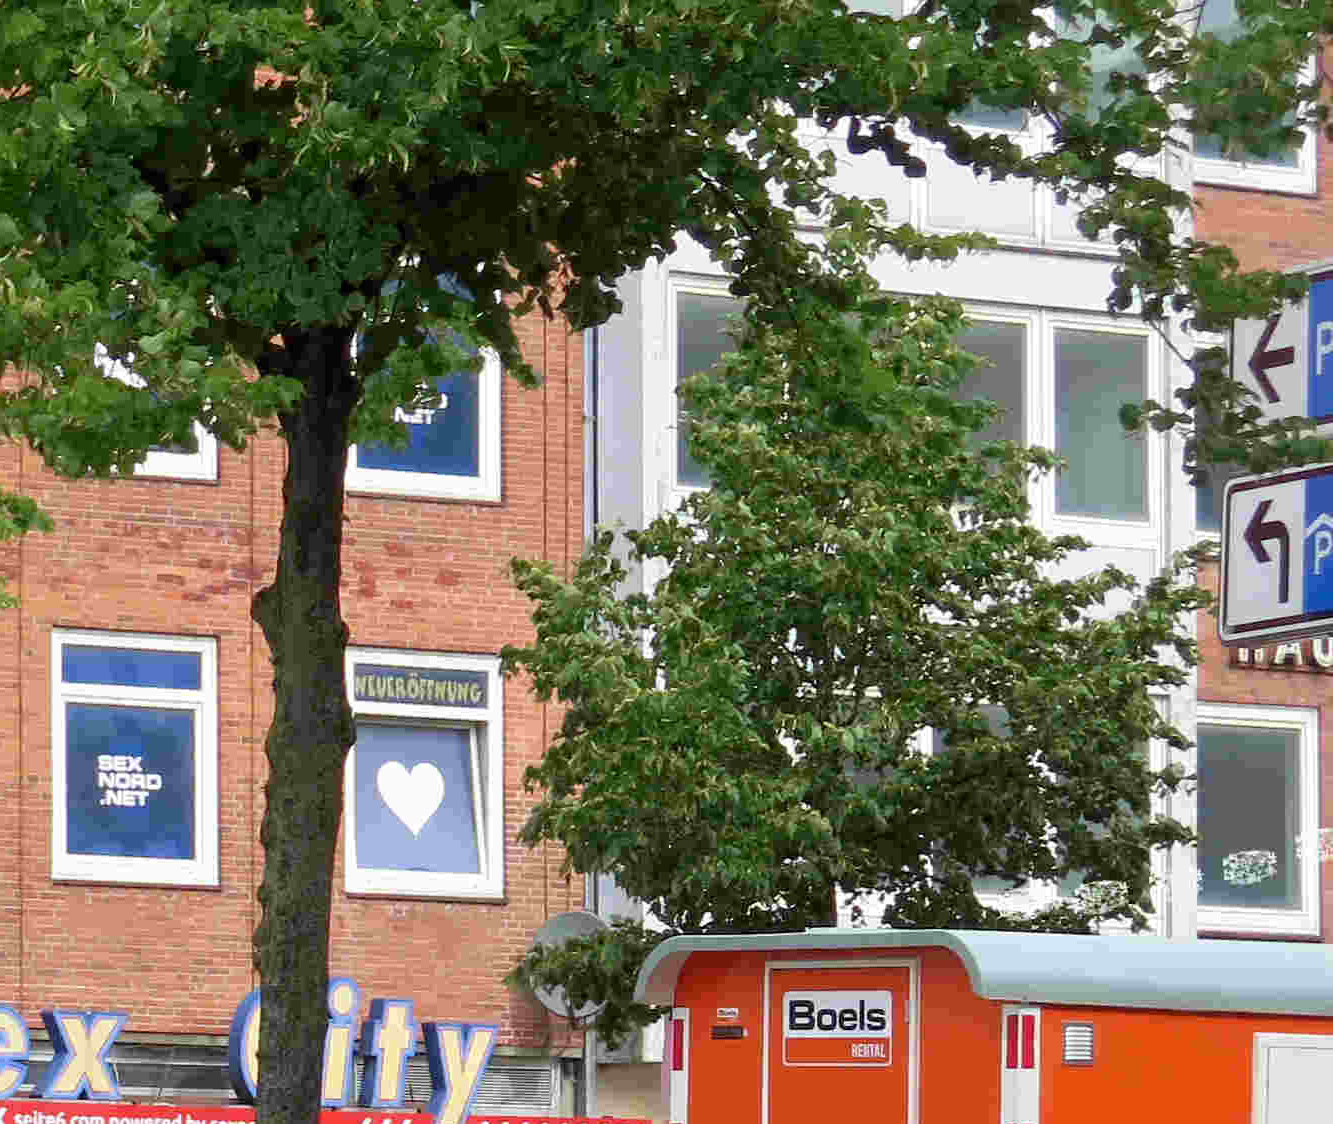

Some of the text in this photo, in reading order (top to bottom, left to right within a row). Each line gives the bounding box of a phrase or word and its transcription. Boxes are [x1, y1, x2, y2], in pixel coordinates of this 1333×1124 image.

[355, 671, 482, 702] NEUERÖFFNUNG
[97, 754, 142, 772] SEX
[97, 771, 163, 790] NORD
[100, 788, 149, 807] .NET
[788, 999, 887, 1031] Boels
[852, 1043, 887, 1058] RENTAL
